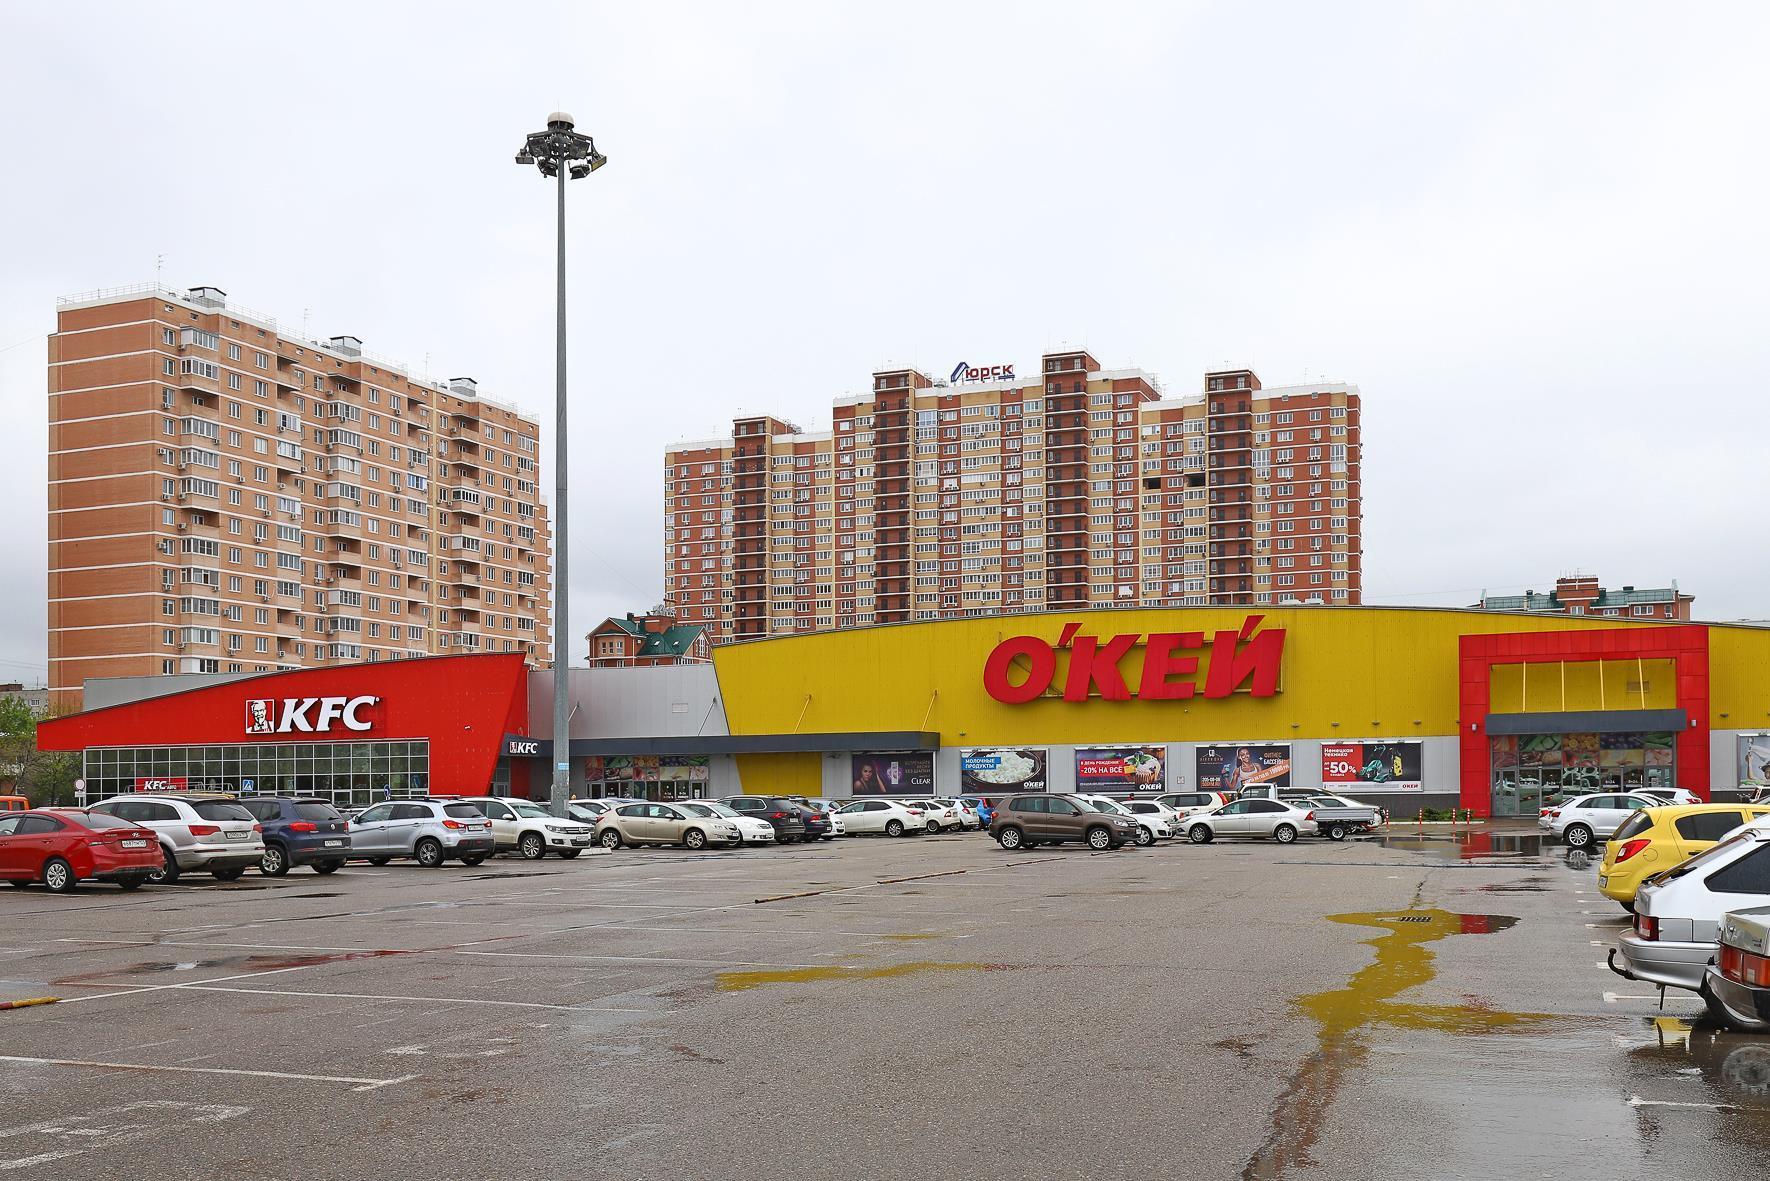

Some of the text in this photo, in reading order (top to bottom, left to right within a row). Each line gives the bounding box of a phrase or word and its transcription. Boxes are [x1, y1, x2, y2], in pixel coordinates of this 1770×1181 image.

[983, 615, 1287, 705] О'КЕЙ
[276, 695, 376, 733] KFC
[517, 742, 538, 754] KFC
[1080, 766, 1098, 774] -20%
[1098, 766, 1109, 774] НА
[144, 780, 167, 790] KFC
